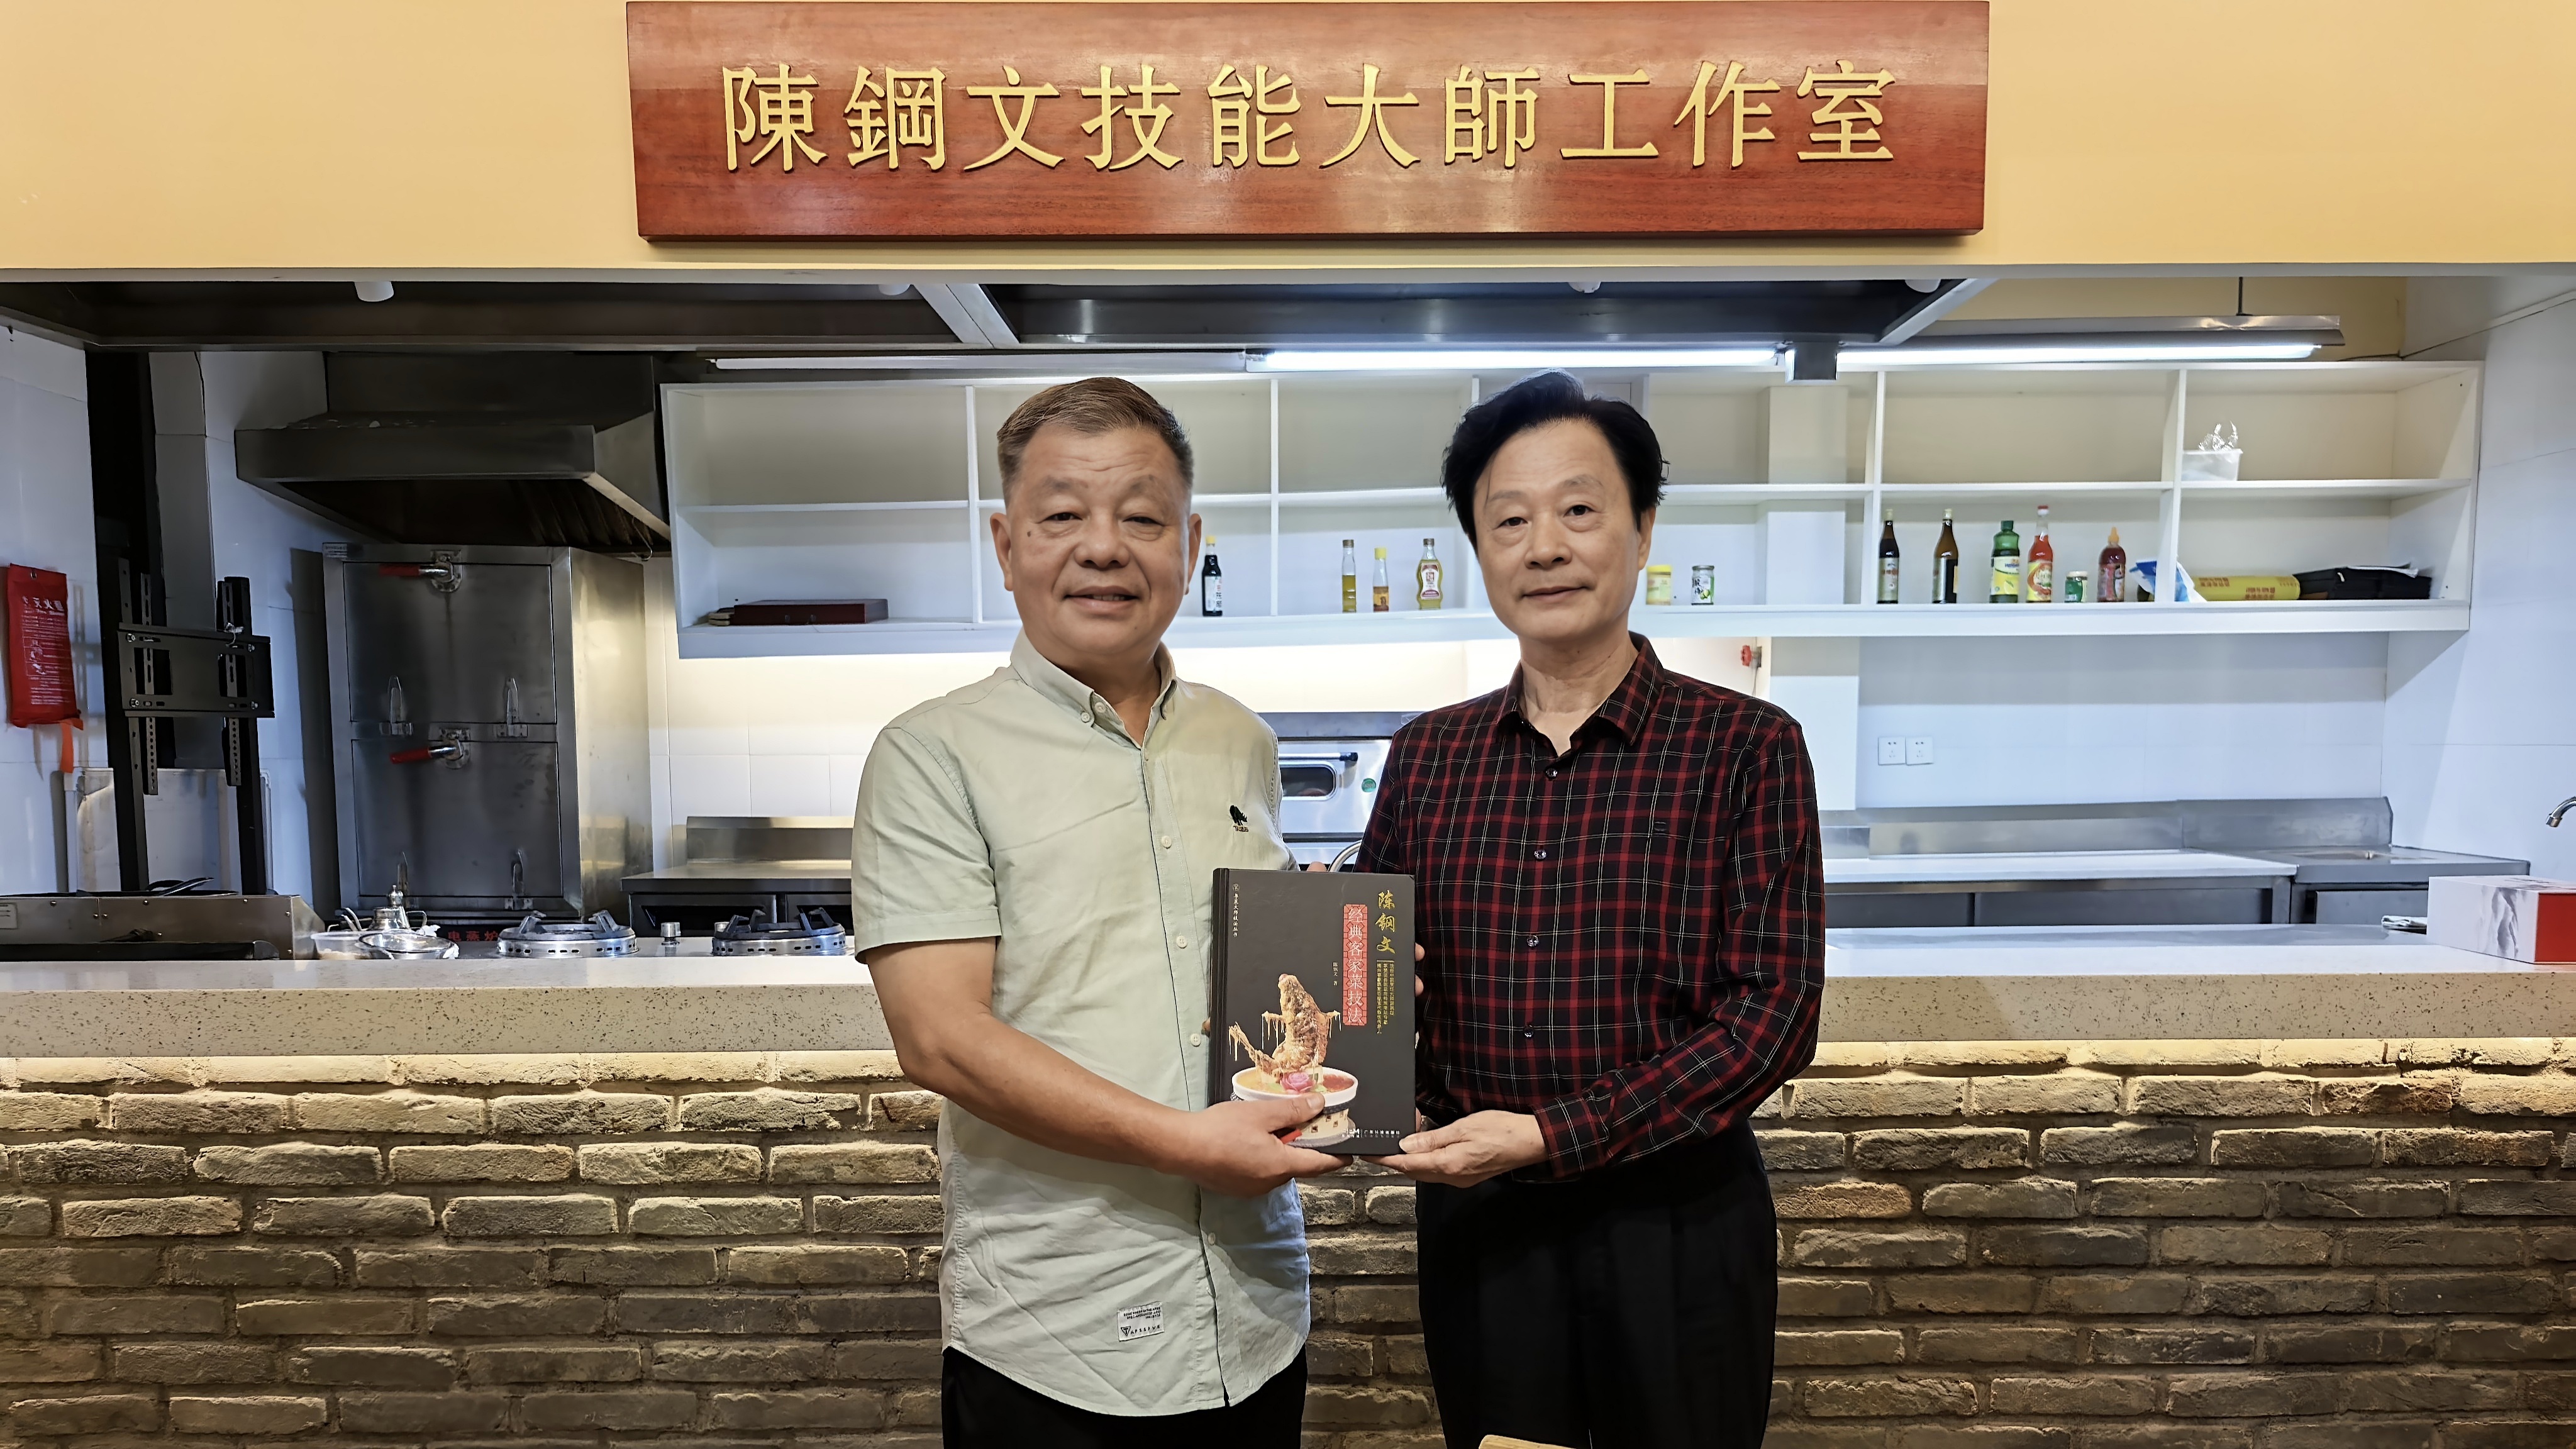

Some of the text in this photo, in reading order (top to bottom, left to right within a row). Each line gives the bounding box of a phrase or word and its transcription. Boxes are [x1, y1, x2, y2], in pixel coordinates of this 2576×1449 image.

[722, 62, 1896, 172] 陳鋼文技能大師工作室
[448, 931, 499, 941] 电蒸炉
[1348, 908, 1363, 1023] 经典客家菜技法
